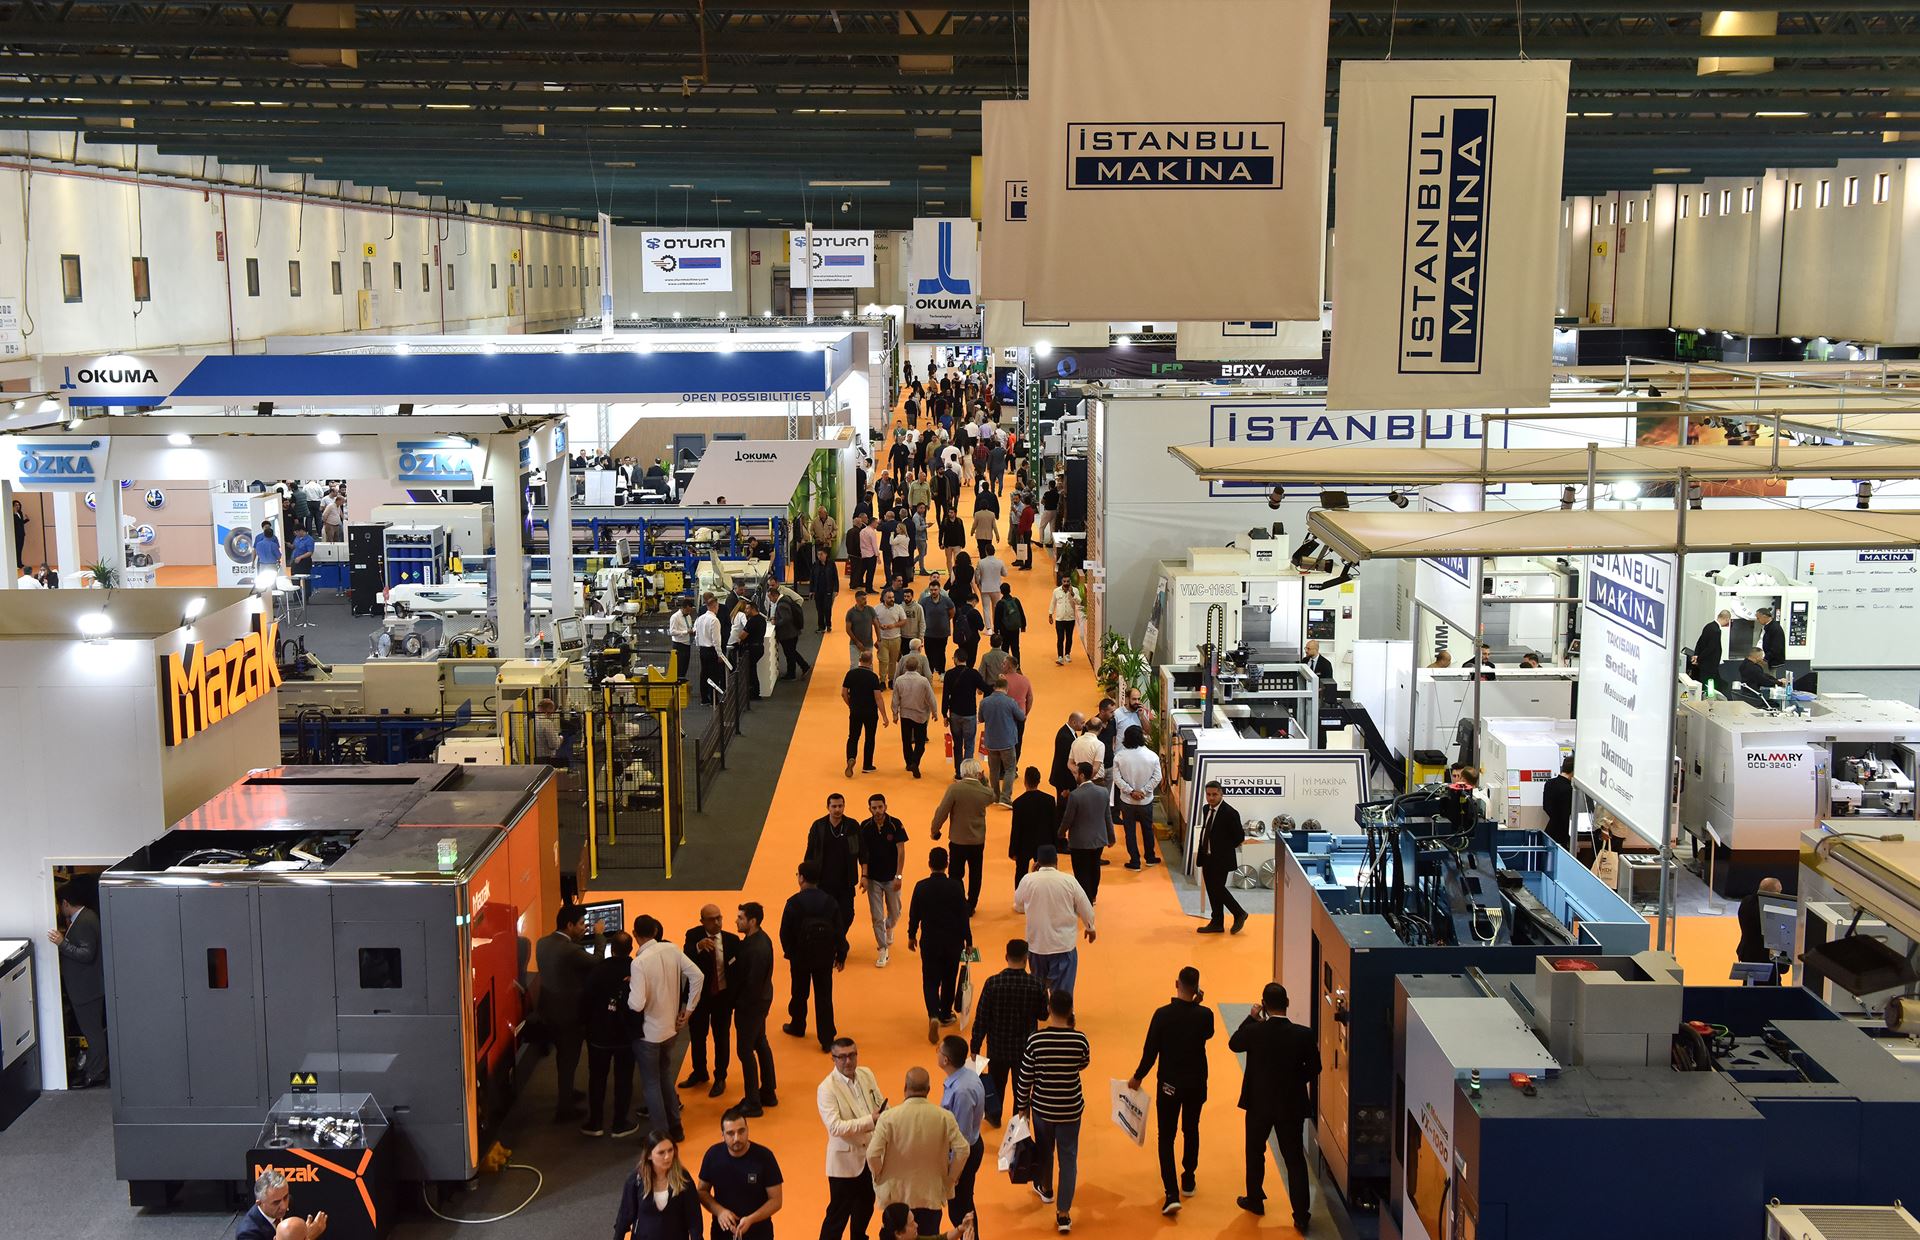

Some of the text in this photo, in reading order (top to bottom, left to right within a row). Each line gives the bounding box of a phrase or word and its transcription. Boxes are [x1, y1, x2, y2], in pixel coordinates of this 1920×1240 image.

[1080, 128, 1270, 151] İSTANBUL
[1097, 158, 1253, 181] MAKİNA
[664, 238, 725, 249] OTURN
[1406, 115, 1445, 358] İSTANBUL
[1449, 135, 1483, 335] MAKİNA
[367, 247, 373, 255] 8
[1597, 244, 1603, 254] 6
[915, 298, 973, 310] OKUMA
[77, 369, 159, 383] OKUMA
[1221, 364, 1266, 377] BOXY
[682, 392, 811, 402] OPEN POSSIBILITIES
[1229, 412, 1483, 442] İSTANBUL
[19, 450, 94, 475] ÖZKA
[399, 448, 474, 475] ÖZKA
[1596, 579, 1656, 630] MAKİNA
[1606, 629, 1641, 661] TAKISAWA
[167, 611, 284, 747] Mazak
[1605, 653, 1638, 686] Sodick
[1610, 713, 1628, 743] KIWA
[1601, 740, 1633, 778] Okamoto
[1747, 753, 1803, 761] PALMARY
[1219, 777, 1281, 786] İSTANBUL
[1225, 786, 1276, 795] MAKİNA
[1314, 777, 1347, 785] MAKİNA
[1314, 788, 1340, 797] SERVİS
[472, 880, 490, 917] Mazak
[1421, 1108, 1448, 1163] VX-1000
